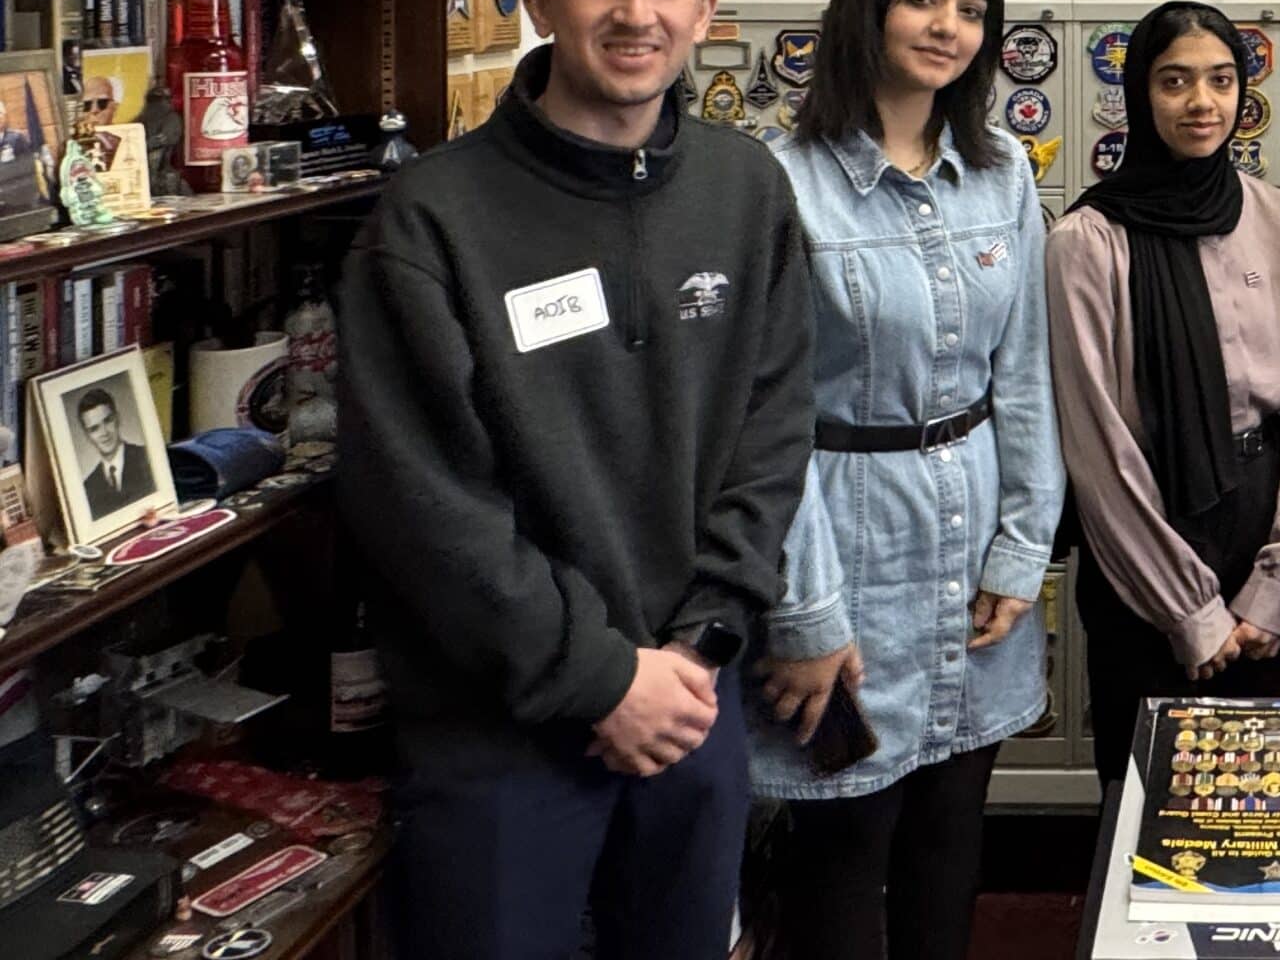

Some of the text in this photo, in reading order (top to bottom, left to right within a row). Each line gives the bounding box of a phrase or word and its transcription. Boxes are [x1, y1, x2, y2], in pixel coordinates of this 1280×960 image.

[1162, 838, 1218, 849] Medals
[1221, 839, 1279, 851] Military
[1241, 849, 1273, 857] Guide
